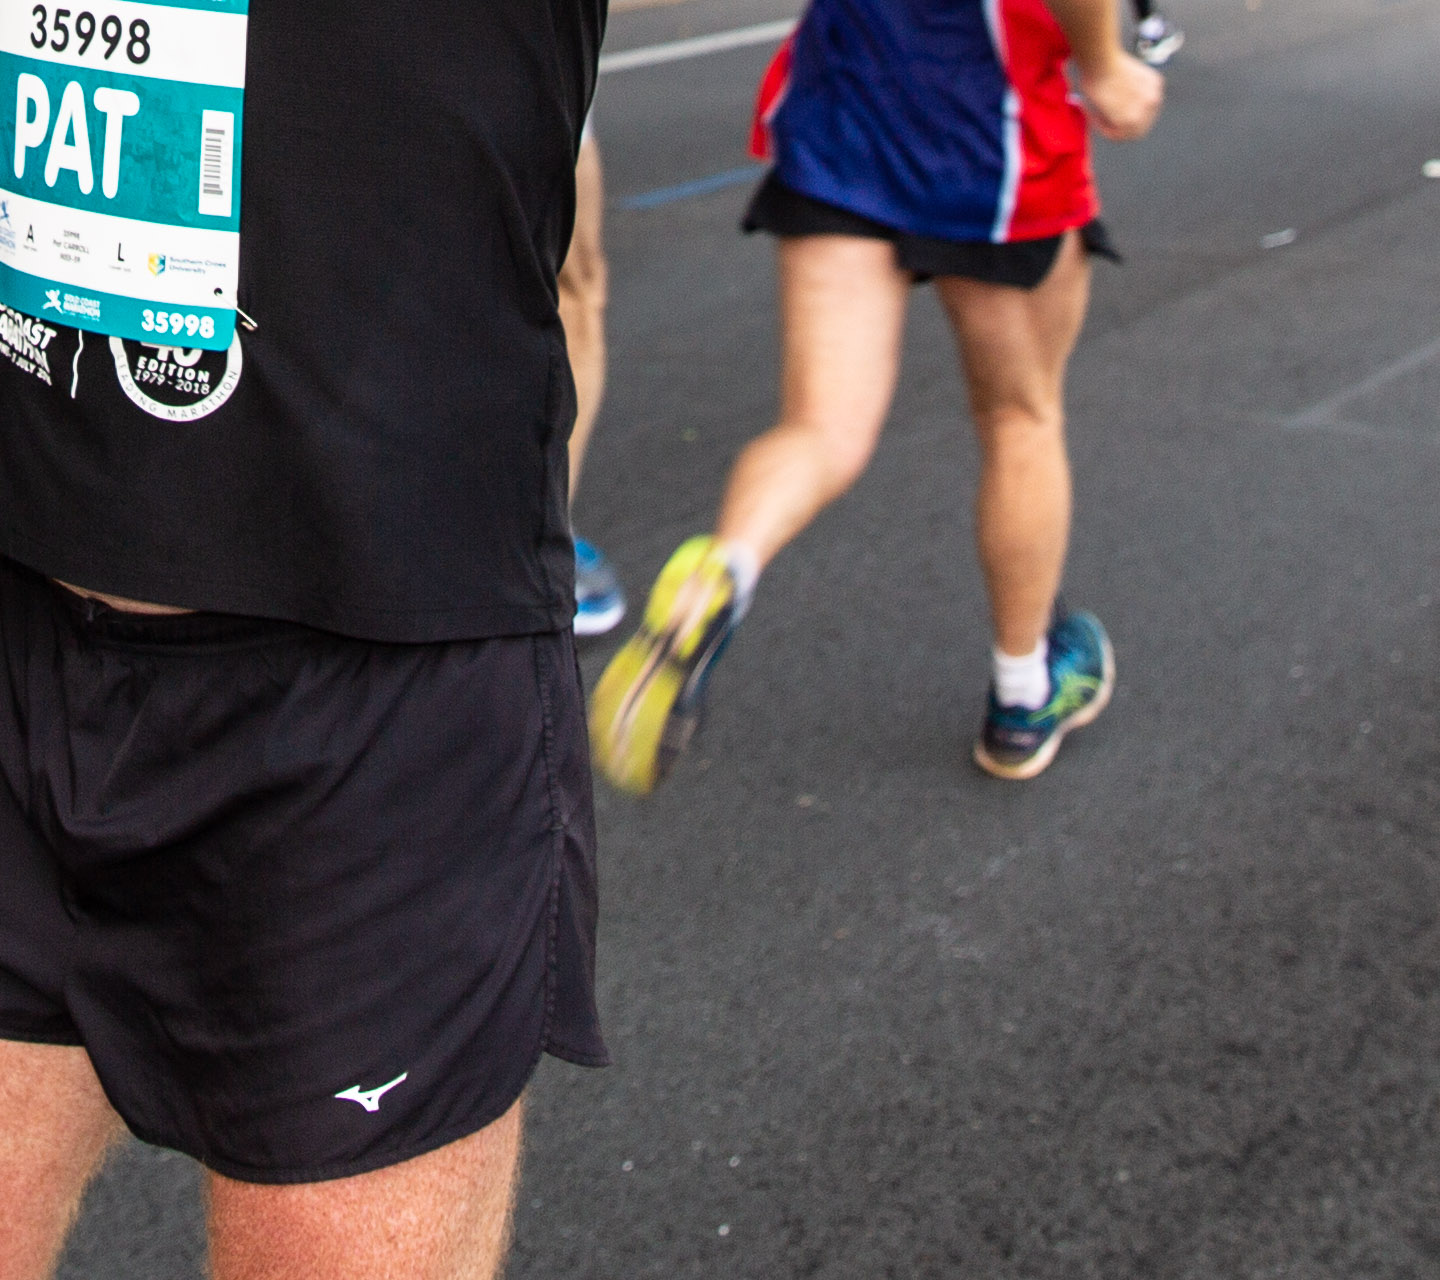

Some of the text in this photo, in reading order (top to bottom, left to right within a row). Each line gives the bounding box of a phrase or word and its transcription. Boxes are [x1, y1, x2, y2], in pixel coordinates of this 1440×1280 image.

[30, 4, 151, 65] 35998
[13, 72, 141, 200] PAT
[26, 224, 35, 243] A
[117, 242, 125, 262] L
[141, 308, 215, 339] 35998
[136, 355, 210, 383] EDITION
[167, 369, 239, 419] MARATHON
